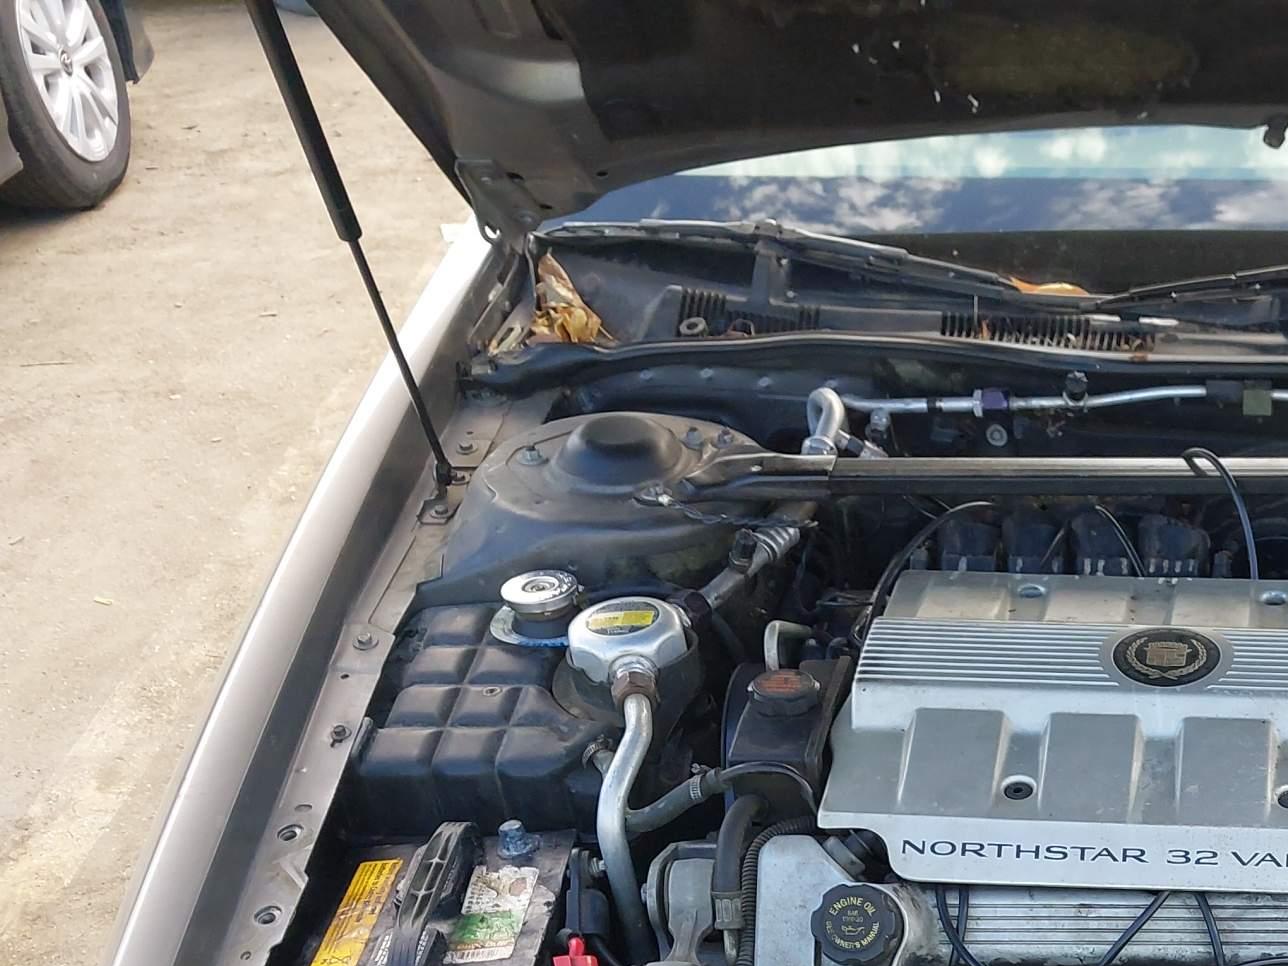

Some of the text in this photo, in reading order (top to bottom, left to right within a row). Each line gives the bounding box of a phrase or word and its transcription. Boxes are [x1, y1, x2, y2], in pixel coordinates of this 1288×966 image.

[901, 838, 1149, 865] NORTHSTAR
[1167, 849, 1219, 866] 32
[829, 896, 863, 916] ENGINE
[864, 902, 876, 917] OIL
[861, 921, 879, 945] MANUAL
